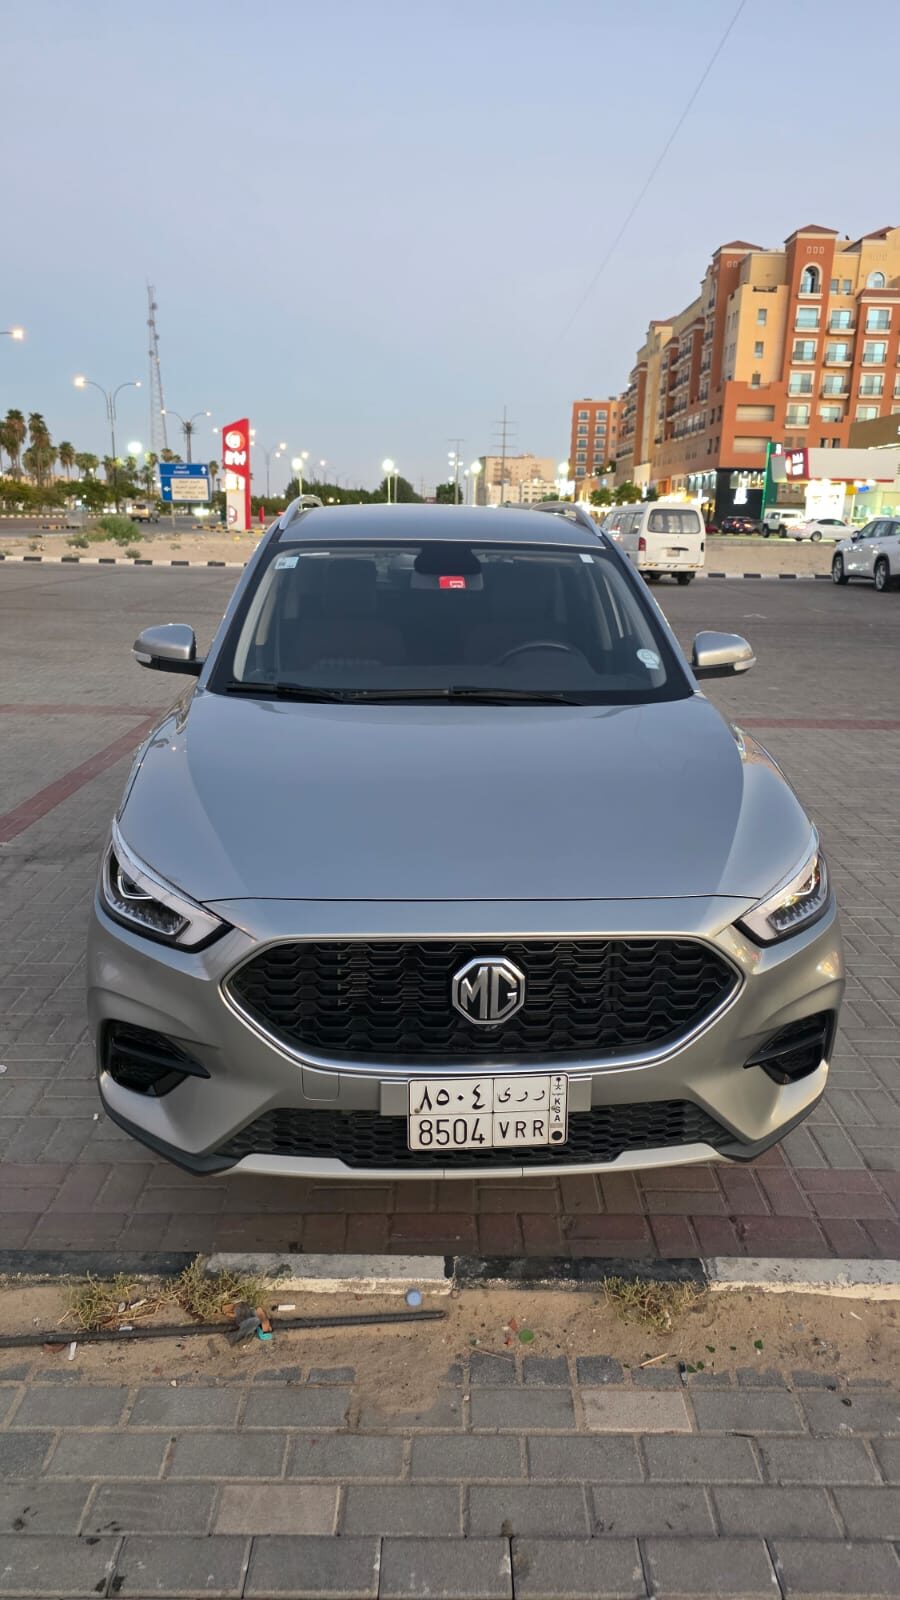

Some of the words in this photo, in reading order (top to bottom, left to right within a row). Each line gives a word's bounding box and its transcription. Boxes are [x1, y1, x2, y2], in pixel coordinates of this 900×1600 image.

[460, 966, 518, 1020] MG
[419, 1084, 486, 1111] ٨٥٠٤
[419, 1118, 485, 1146] 8504
[499, 1119, 545, 1139] VRR
